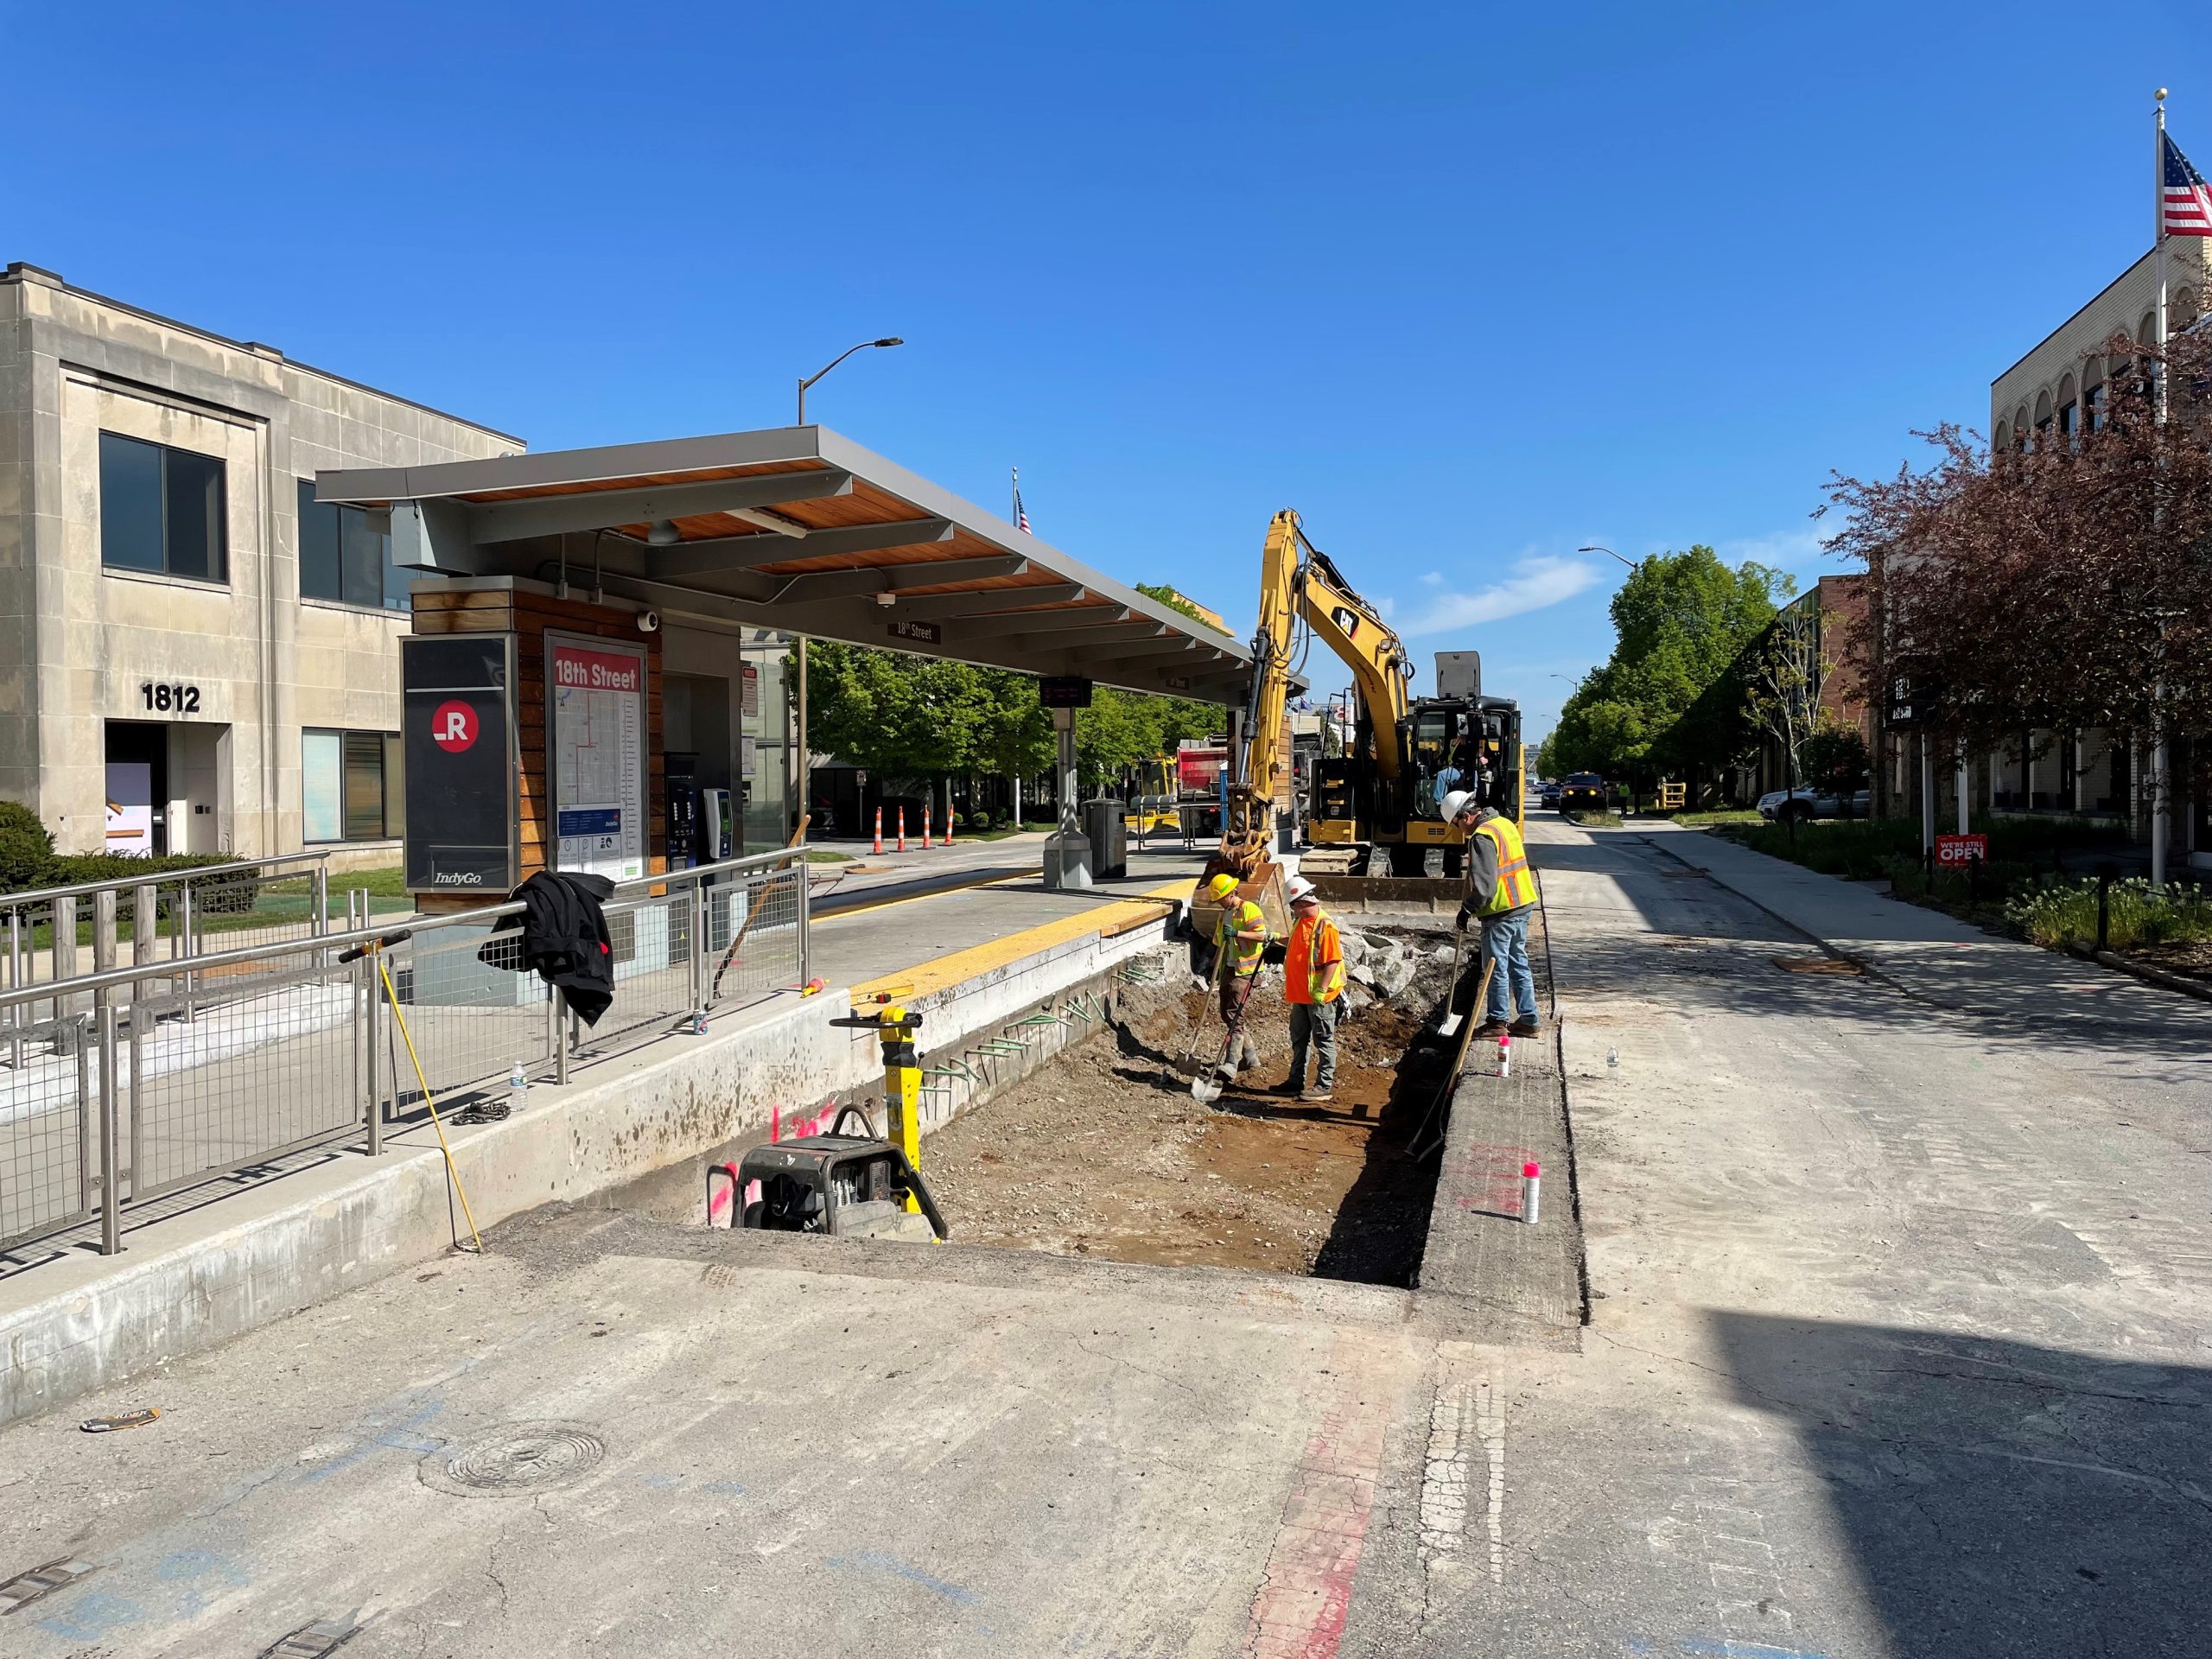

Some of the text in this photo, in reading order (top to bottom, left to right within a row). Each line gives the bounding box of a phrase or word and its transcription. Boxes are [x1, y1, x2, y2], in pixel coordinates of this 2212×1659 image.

[897, 621, 932, 640] 18th Street
[1340, 609, 1353, 636] CAT
[556, 659, 636, 690] 18th Street
[142, 683, 200, 713] 1812
[1940, 847, 1985, 861] OPEN
[434, 872, 482, 886] IndyGo
